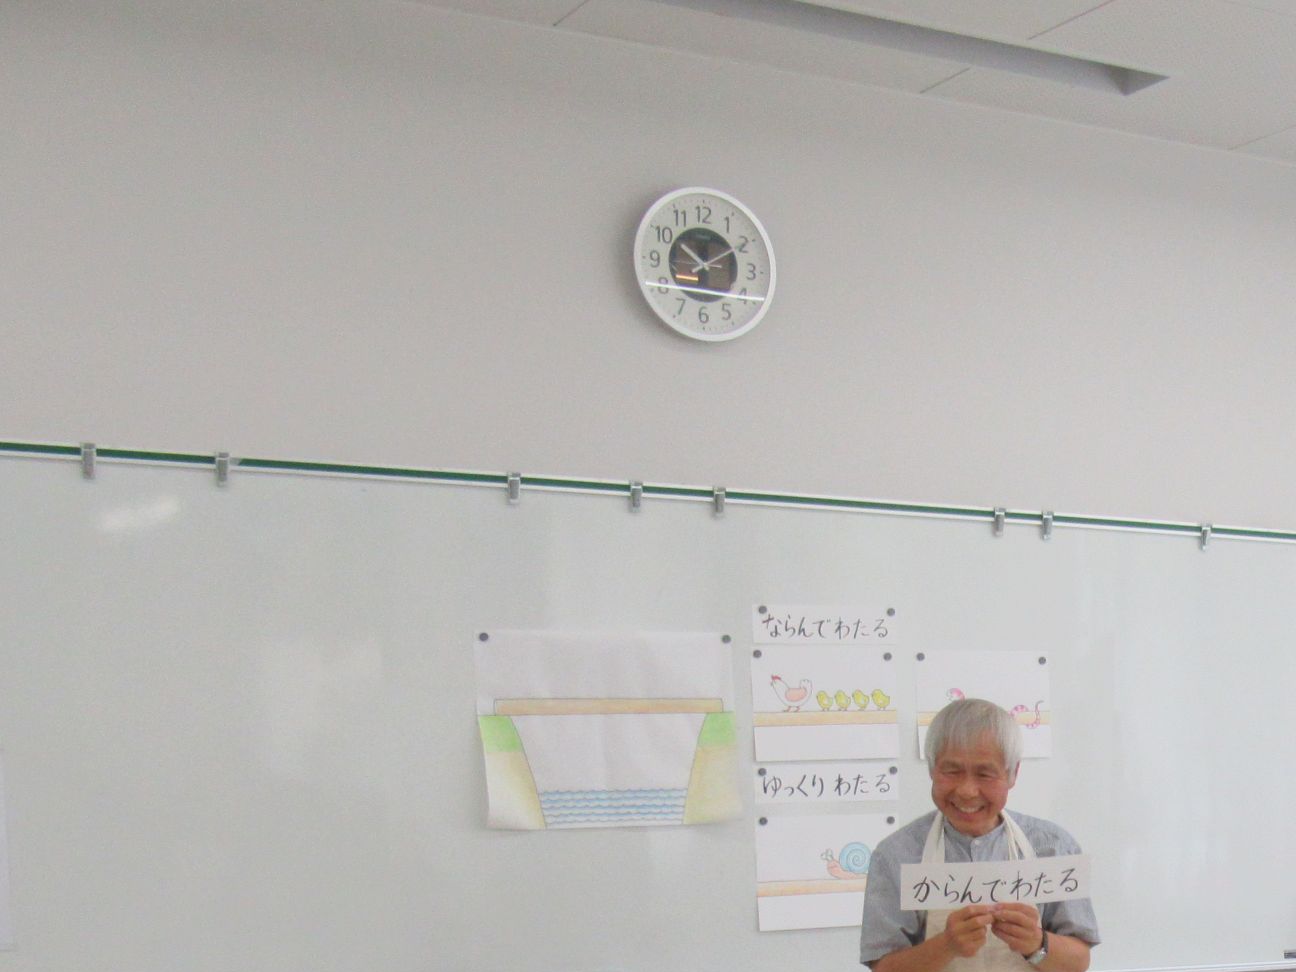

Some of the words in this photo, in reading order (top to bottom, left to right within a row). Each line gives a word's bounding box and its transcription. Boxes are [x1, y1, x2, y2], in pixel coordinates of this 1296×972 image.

[673, 209, 687, 227] 11
[695, 205, 712, 225] 12
[656, 225, 673, 244] 10
[738, 235, 749, 254] 2
[649, 250, 661, 268] 9
[746, 263, 757, 281] 3
[675, 298, 686, 315] 7
[698, 306, 710, 324] 6
[721, 303, 732, 321] 5
[762, 614, 889, 640] ならんでわたる
[763, 774, 824, 798] ゆっくり
[834, 773, 891, 795] わたる
[912, 868, 1080, 905] からんでわたる
